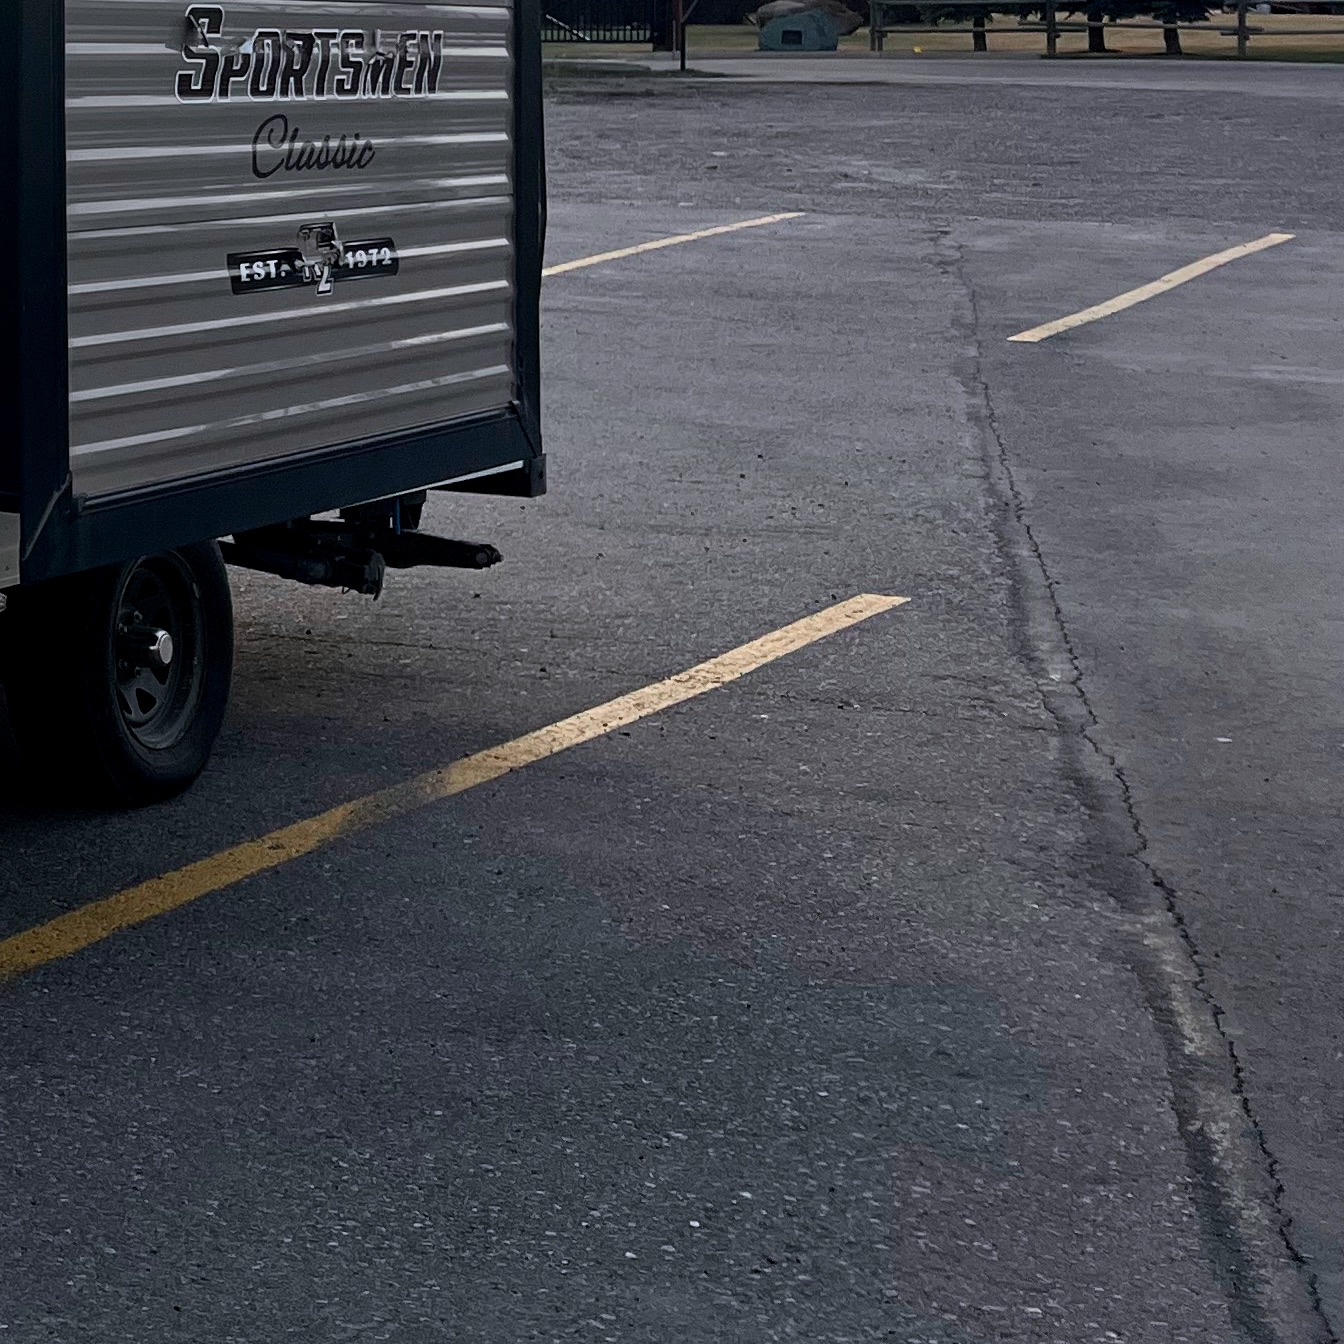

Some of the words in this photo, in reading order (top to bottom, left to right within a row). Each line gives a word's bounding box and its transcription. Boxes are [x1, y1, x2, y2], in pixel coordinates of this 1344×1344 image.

[252, 114, 376, 179] Classic
[239, 260, 286, 282] EST.
[345, 247, 393, 269] 1972
